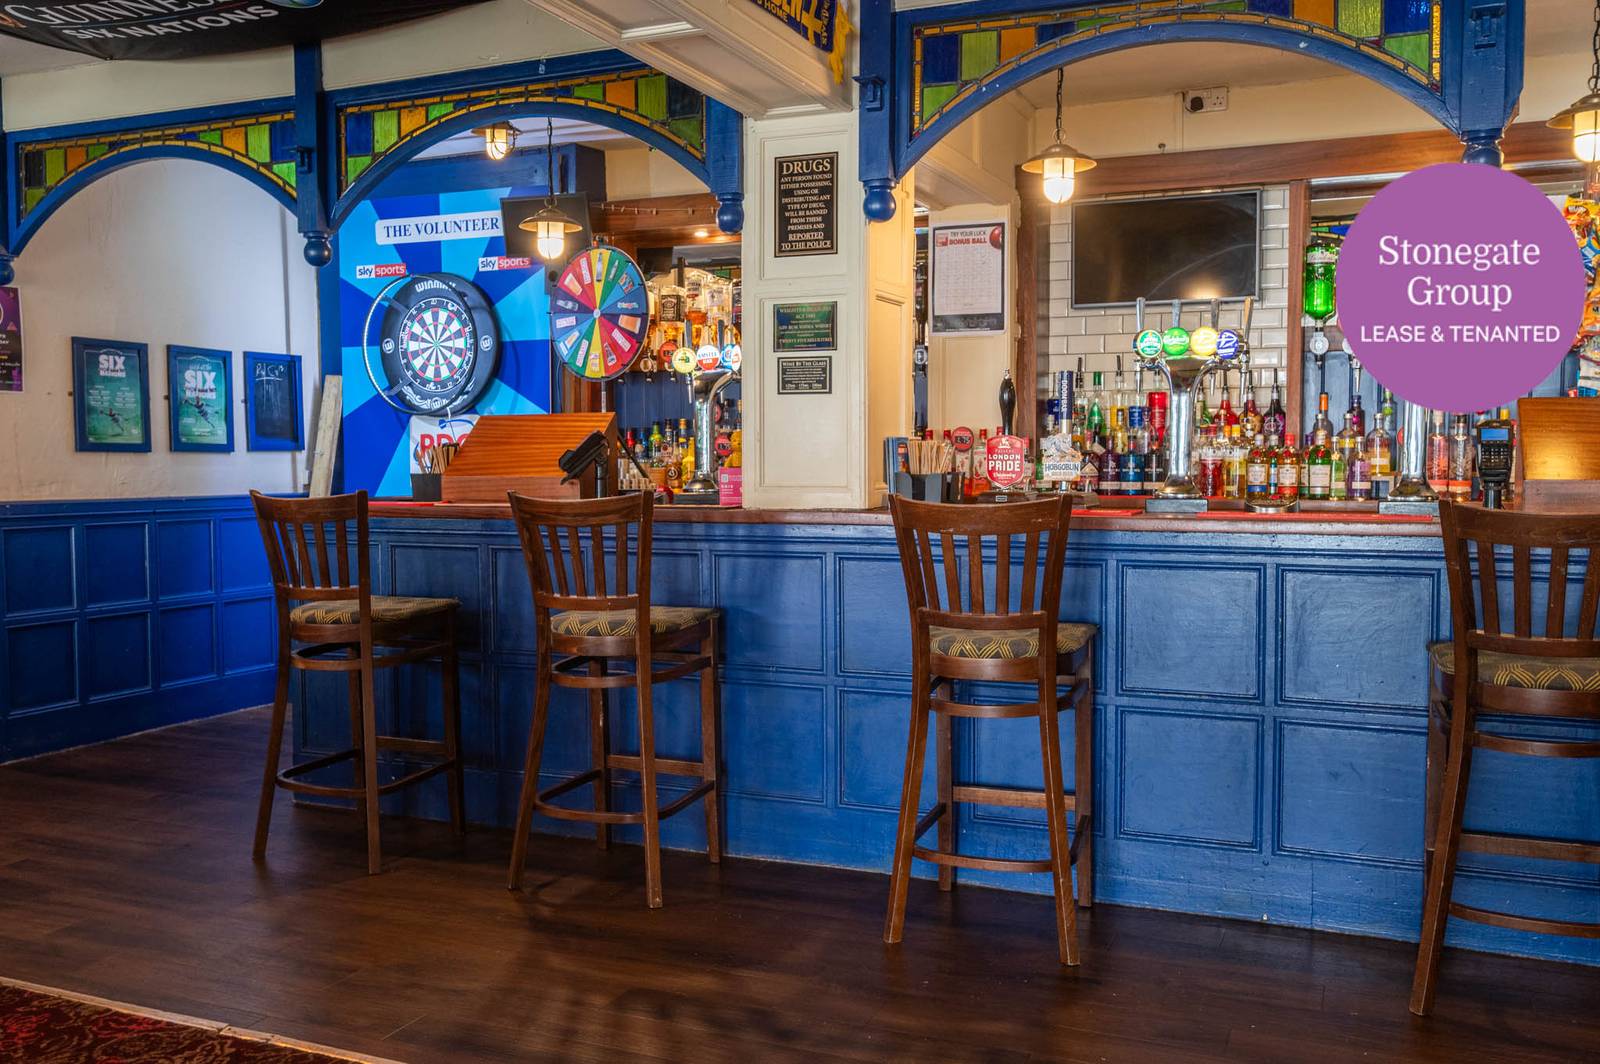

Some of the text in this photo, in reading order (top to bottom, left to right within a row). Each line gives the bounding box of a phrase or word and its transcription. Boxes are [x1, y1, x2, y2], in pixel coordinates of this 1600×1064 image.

[4, 0, 233, 25] GUINNE
[62, 4, 280, 40] SIX NATIONS
[782, 158, 831, 174] DRUGS
[383, 216, 500, 238] THE VOLUNTEER
[788, 232, 824, 240] REPORTED
[792, 242, 806, 250] THE
[806, 240, 832, 249] POLICE
[358, 264, 404, 278] sky sports
[480, 257, 530, 270] sky sports
[98, 354, 126, 370] SIX
[184, 370, 216, 389] SIX
[988, 460, 1021, 471] PRIDE
[1044, 463, 1080, 472] HOBGOBLIN
